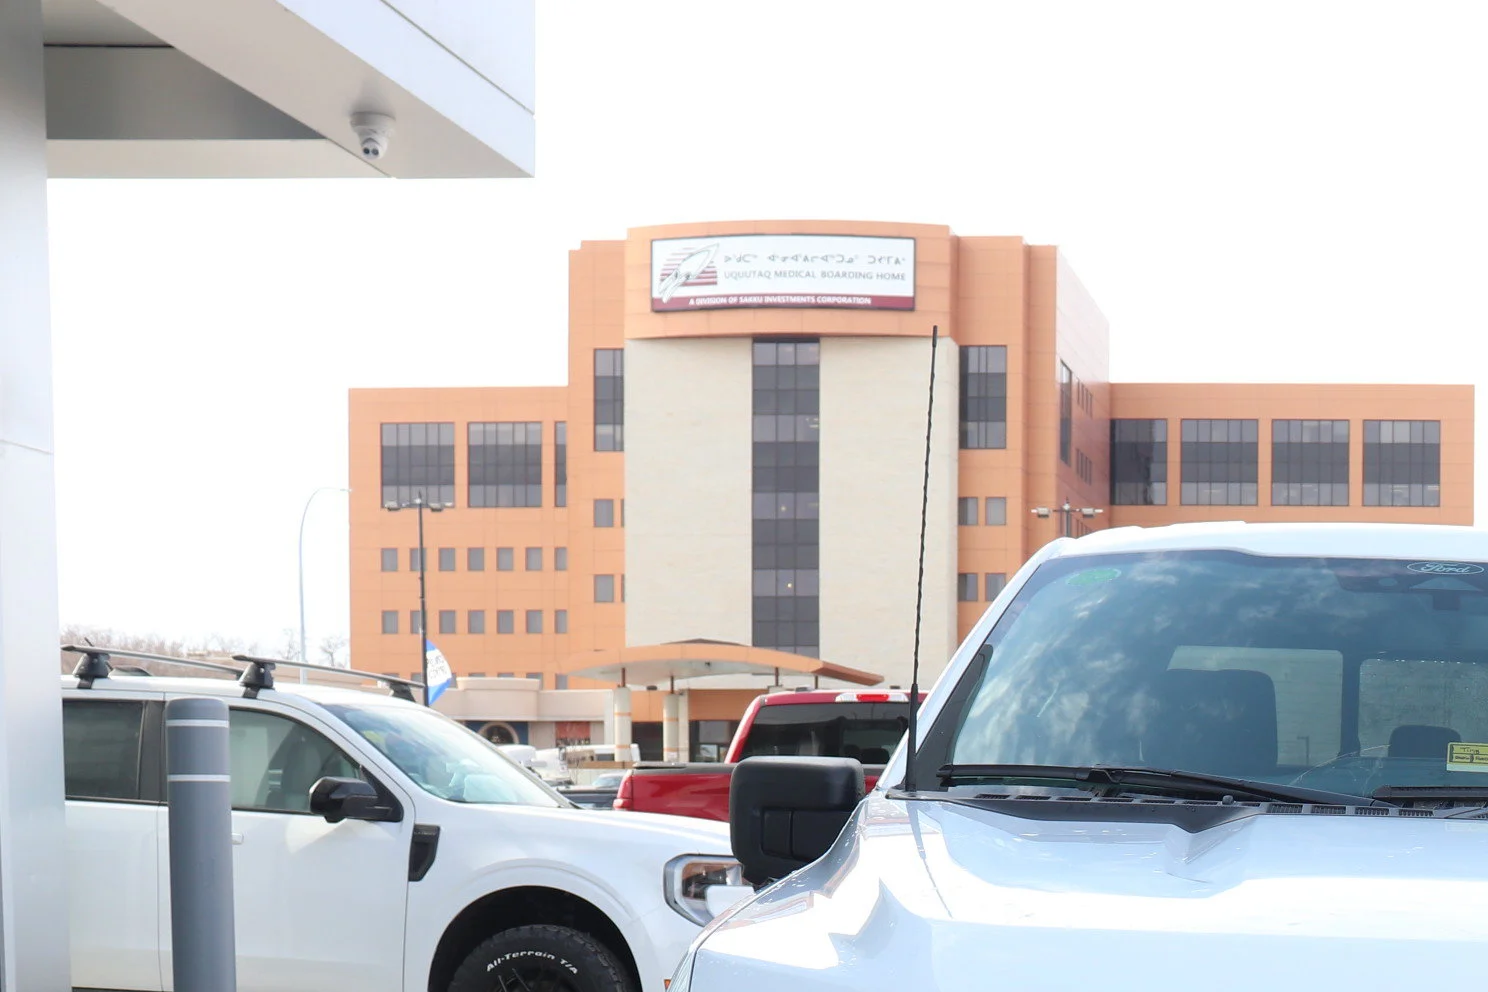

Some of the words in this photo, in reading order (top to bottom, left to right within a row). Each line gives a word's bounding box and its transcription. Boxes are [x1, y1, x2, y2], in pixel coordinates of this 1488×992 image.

[723, 270, 771, 281] UQUUTAQ
[773, 270, 817, 279] MEDICAL
[820, 270, 873, 280] BOARDING
[876, 271, 906, 281] HOME
[695, 296, 727, 306] DIVISION
[728, 295, 738, 304] OF
[764, 295, 816, 304] INVESTMENTS
[816, 295, 872, 305] CORPORATION
[1420, 562, 1470, 574] Ford
[486, 950, 556, 972] All-Terrain
[558, 957, 579, 975] T/A
